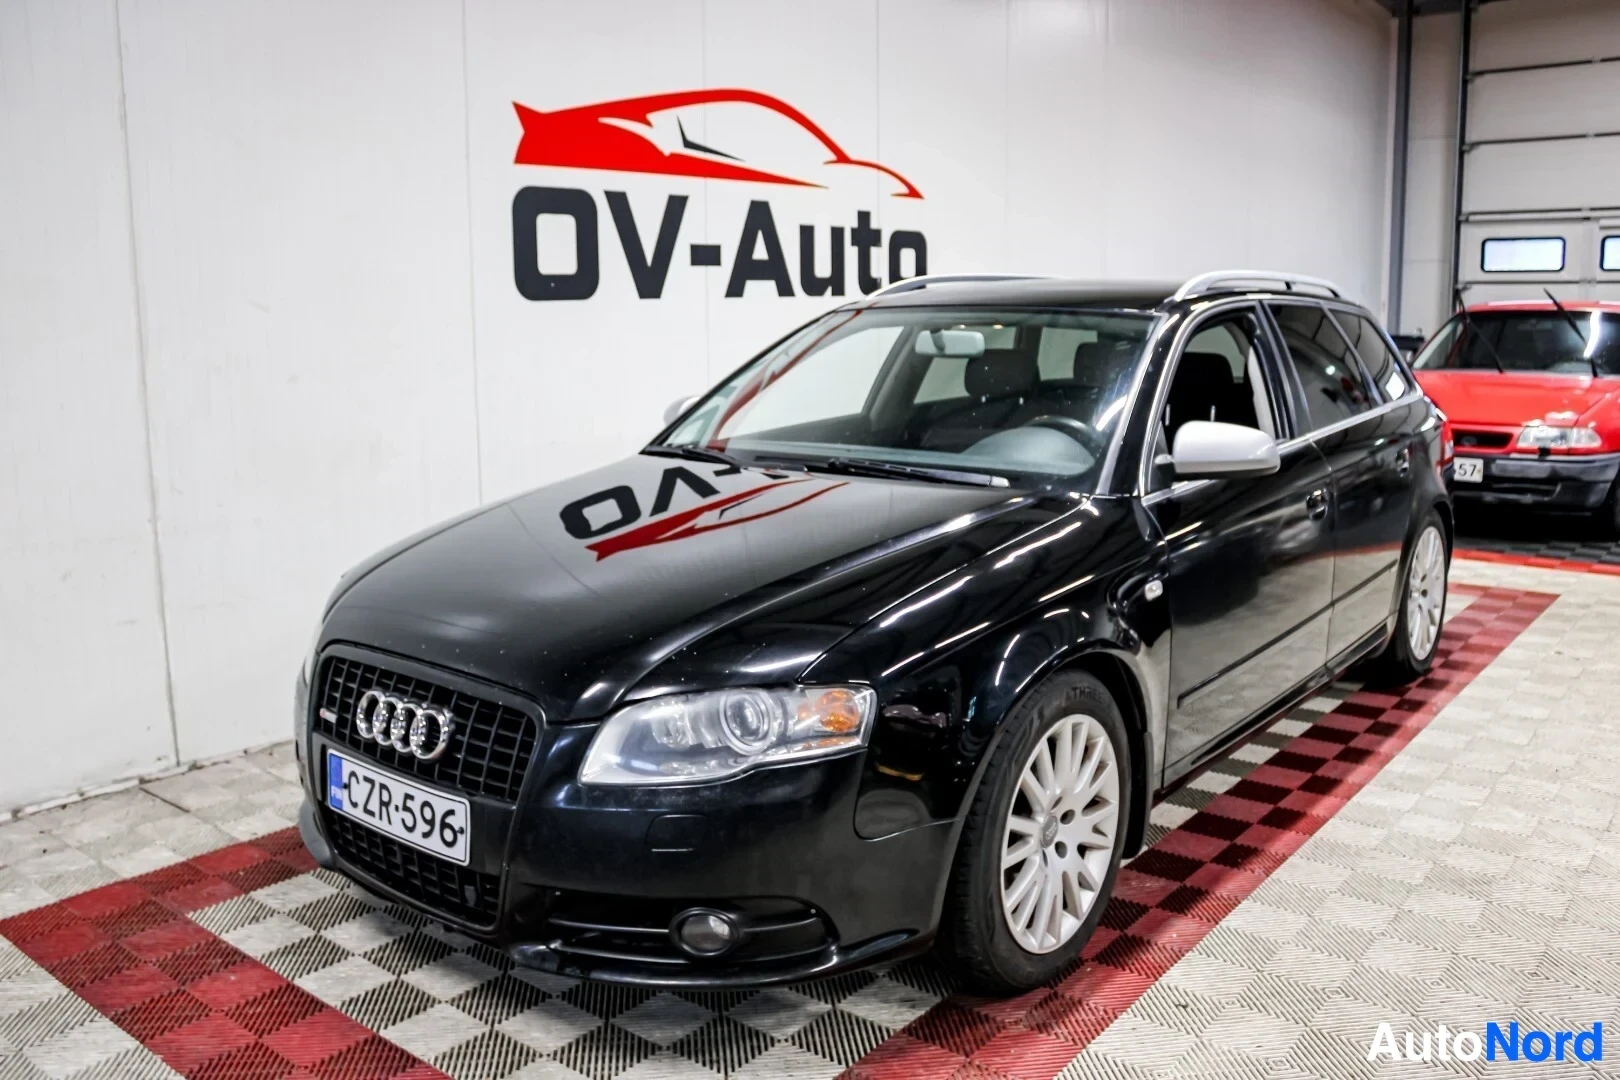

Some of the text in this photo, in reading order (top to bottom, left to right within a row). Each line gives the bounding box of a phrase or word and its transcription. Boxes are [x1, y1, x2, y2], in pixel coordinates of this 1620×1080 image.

[512, 185, 928, 301] OV-Auto
[1454, 463, 1477, 477] 57
[347, 770, 458, 848] CZR-596
